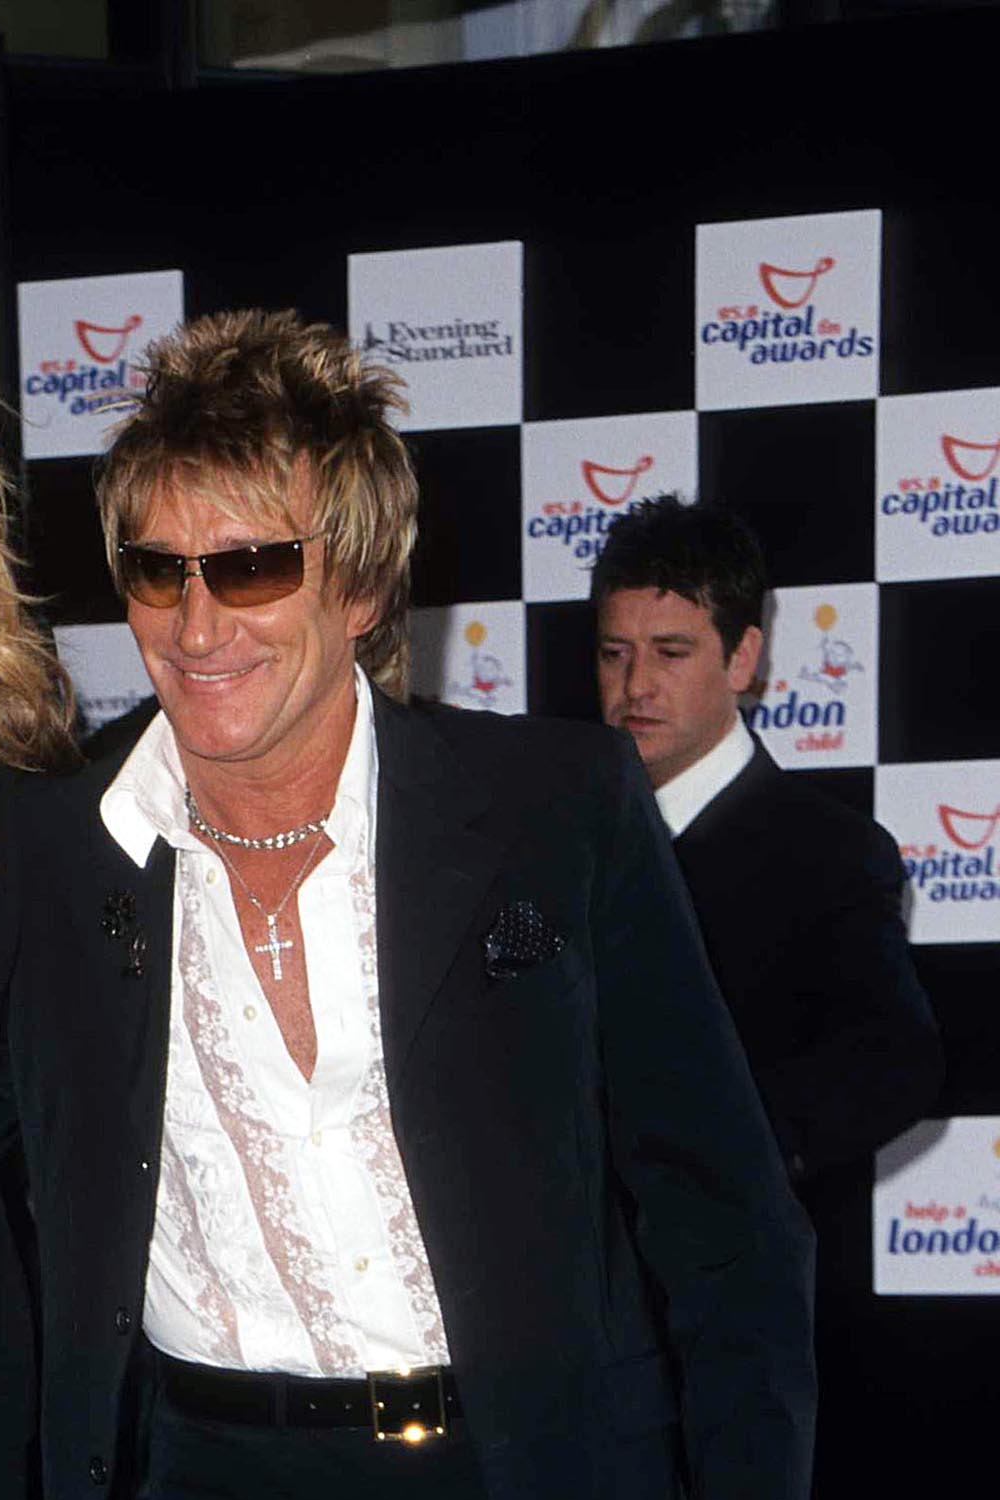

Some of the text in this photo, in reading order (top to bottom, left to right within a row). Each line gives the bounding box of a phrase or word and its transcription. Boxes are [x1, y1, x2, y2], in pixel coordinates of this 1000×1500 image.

[388, 318, 499, 343] Evening
[702, 305, 814, 351] capital
[750, 328, 873, 365] awards
[386, 335, 512, 364] Standard
[27, 360, 125, 402] capital
[881, 477, 997, 522] capital
[932, 513, 1000, 536] awa
[749, 691, 845, 729] ndon
[903, 845, 994, 888] apital
[930, 881, 1000, 902] awa
[889, 1218, 1000, 1255] londo
